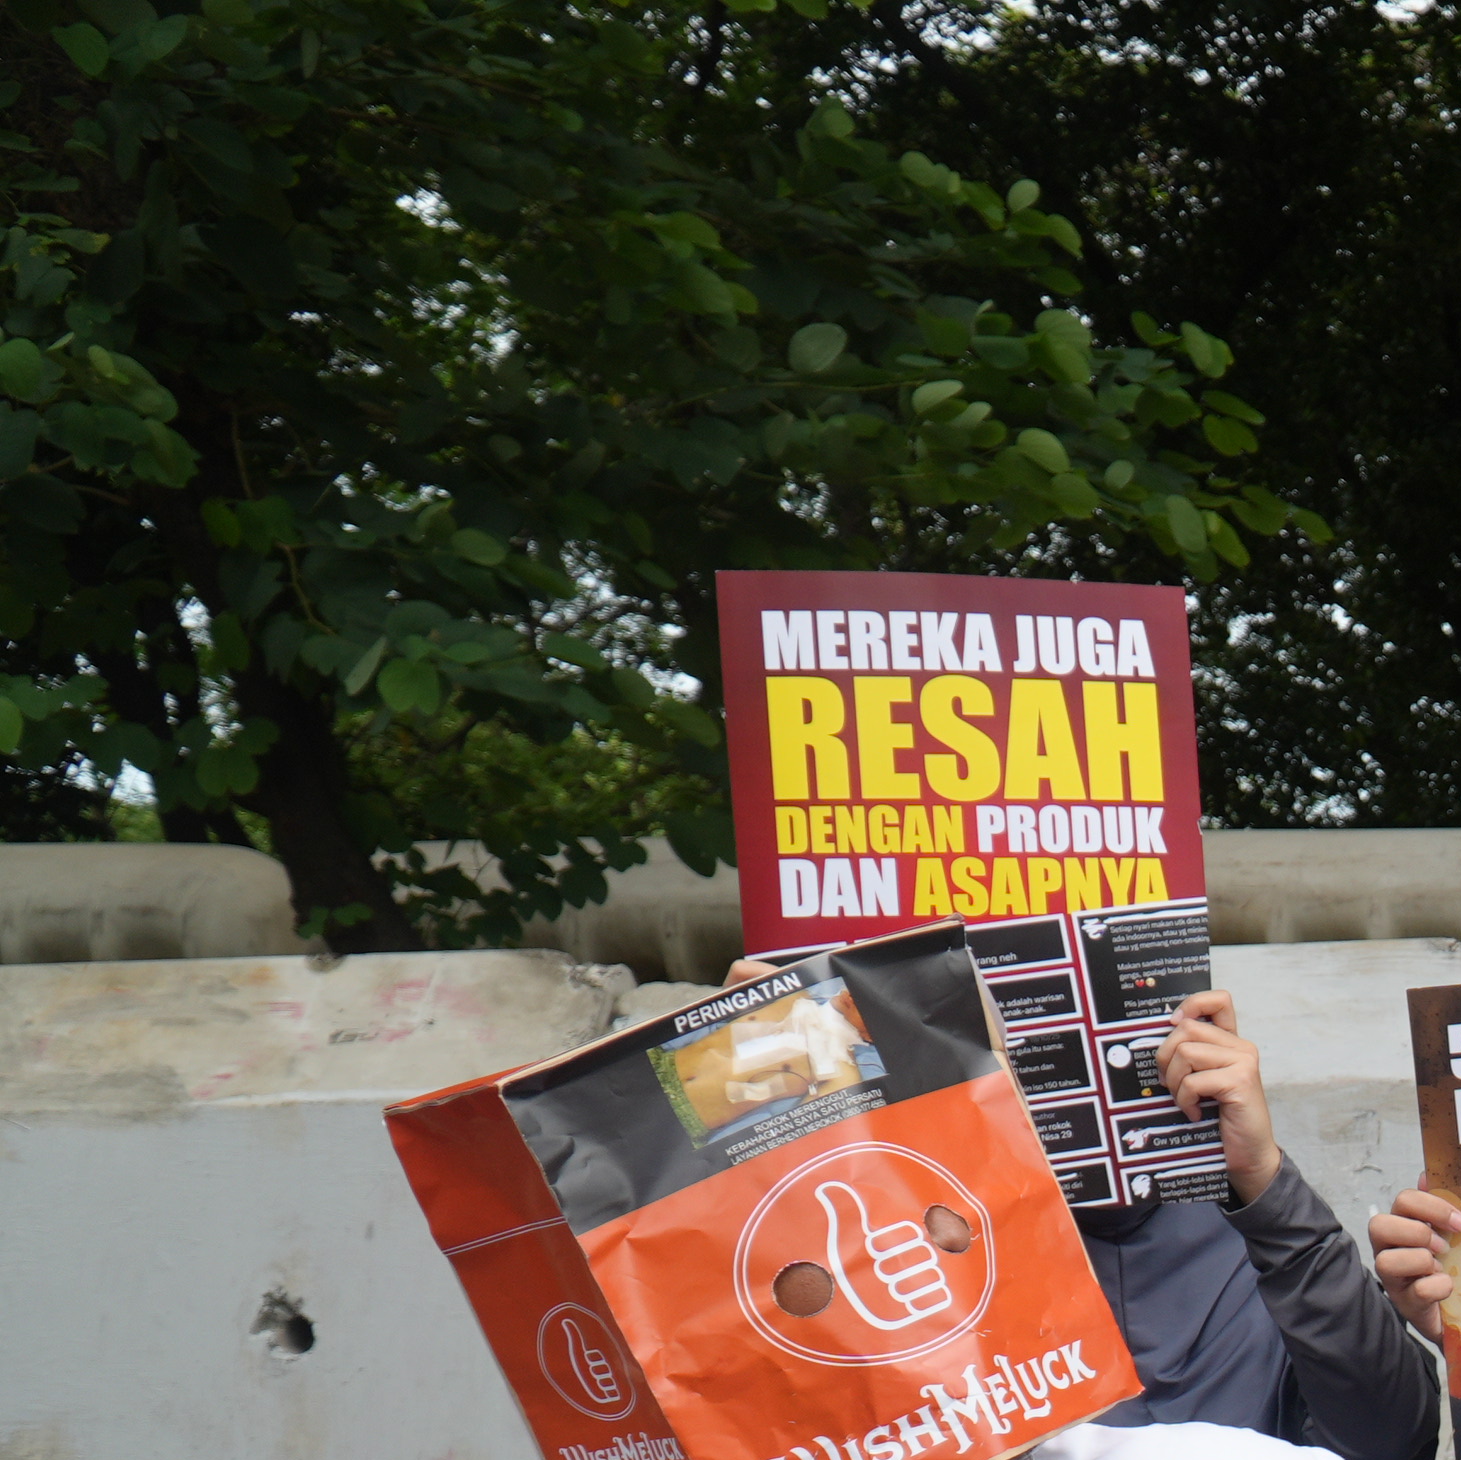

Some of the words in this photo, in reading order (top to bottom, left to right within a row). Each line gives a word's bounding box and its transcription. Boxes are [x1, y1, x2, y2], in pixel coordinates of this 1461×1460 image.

[761, 610, 1002, 673] MEREKA
[1014, 614, 1155, 677] JUGA
[766, 674, 1164, 802] RESAH
[775, 805, 965, 854] DENGAN
[976, 805, 1168, 854] PRODUK
[779, 857, 899, 917] DAN
[913, 857, 1169, 916] ASAPNYA
[1110, 923, 1133, 935] Setiap
[1151, 919, 1173, 929] makan
[999, 952, 1017, 962] neh
[1117, 961, 1141, 972] Makan
[1165, 956, 1182, 967] hirup
[674, 971, 803, 1034] PERINGATAN
[1006, 997, 1033, 1007] adalah
[1034, 993, 1064, 1004] warisan
[1134, 1050, 1151, 1060] BISA
[725, 1122, 795, 1157] KEBAHAGIAAN
[794, 1110, 822, 1130] SAYA
[821, 1100, 846, 1117] SATU
[845, 1087, 883, 1109] PERSATU
[754, 1113, 790, 1134] ROKOK
[1048, 1121, 1072, 1131] rokok
[730, 1144, 768, 1166] LAYANAN
[767, 1129, 804, 1151] BERHENTI
[804, 1114, 843, 1135] MEROKOK
[1062, 1129, 1073, 1139] 29
[1169, 1135, 1181, 1147] yg
[1181, 1133, 1193, 1144] gk
